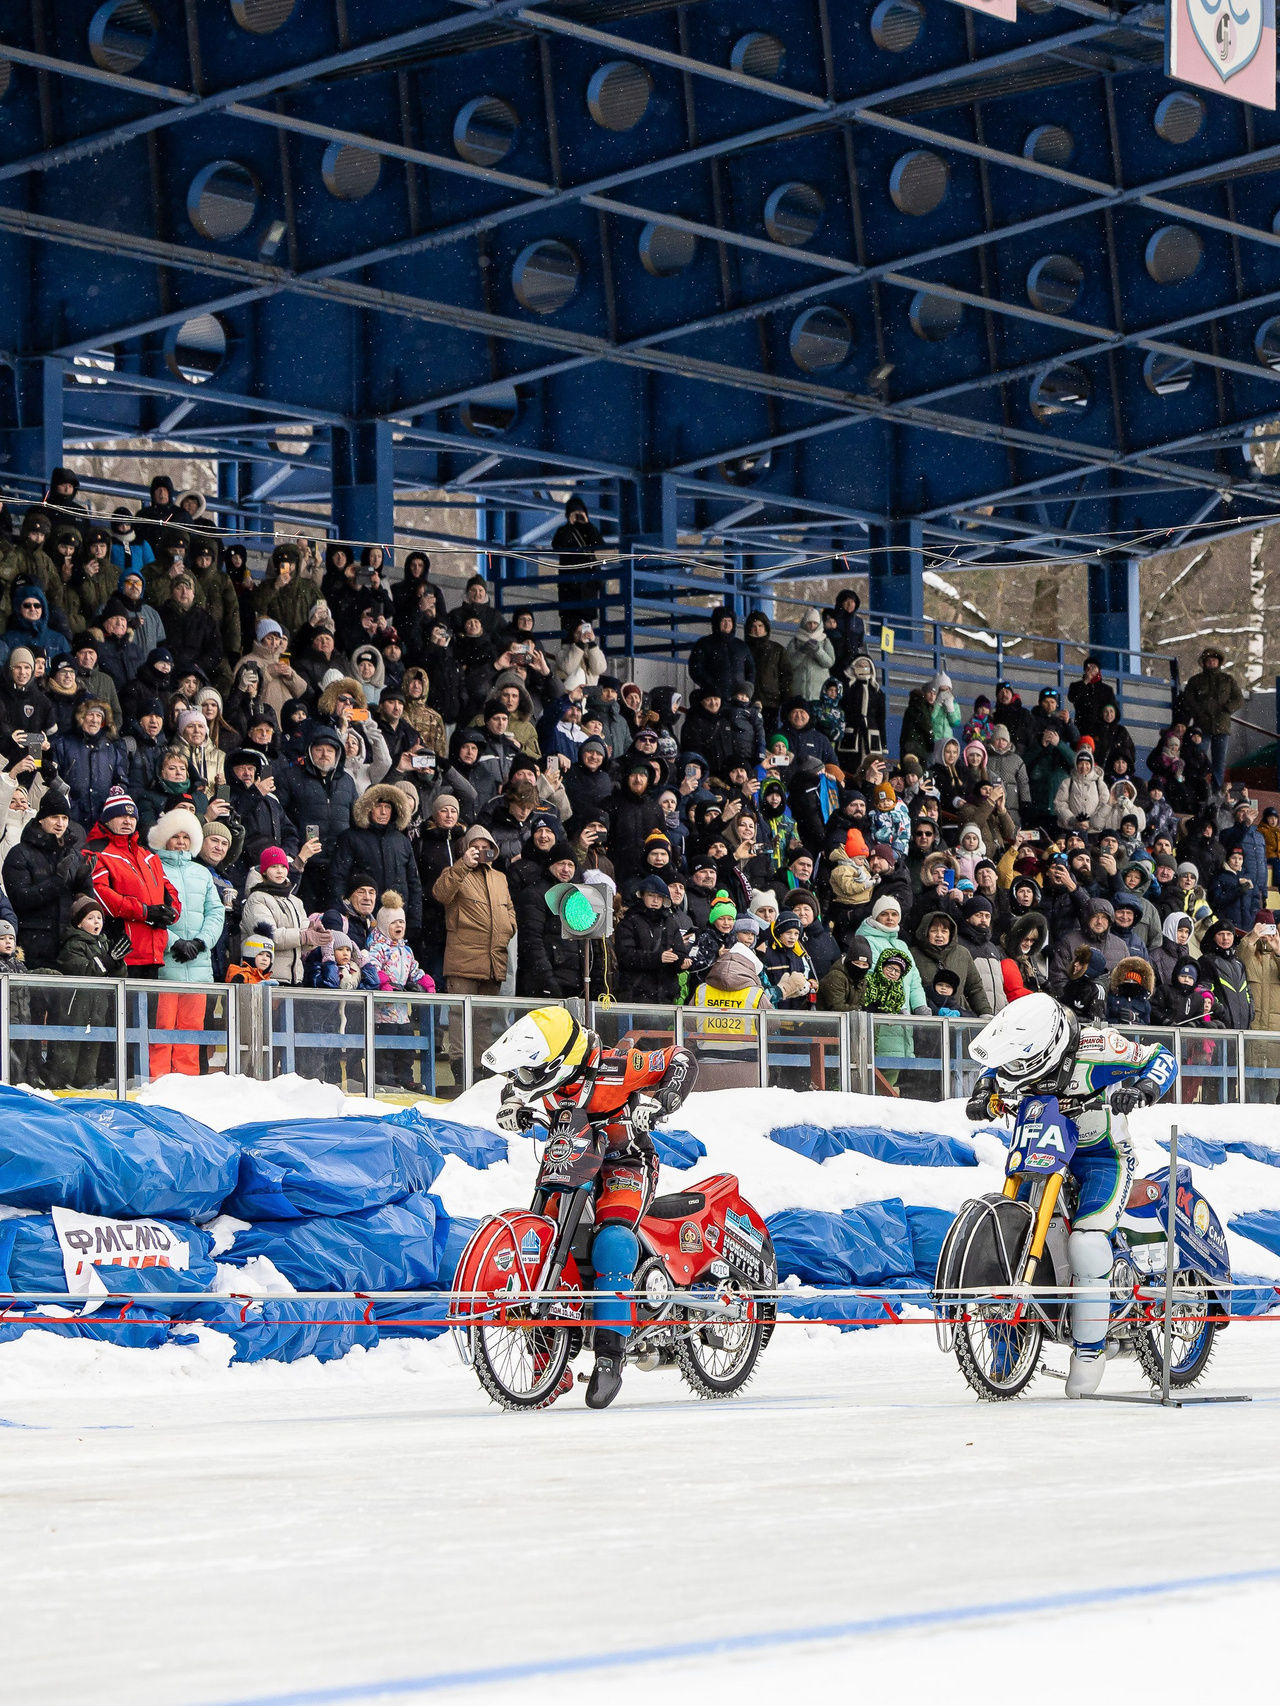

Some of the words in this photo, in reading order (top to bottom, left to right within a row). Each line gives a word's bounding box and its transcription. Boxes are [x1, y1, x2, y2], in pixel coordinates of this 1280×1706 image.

[707, 999, 742, 1008] SAFETY
[707, 1017, 741, 1029] K0322
[1147, 1054, 1175, 1085] UFA
